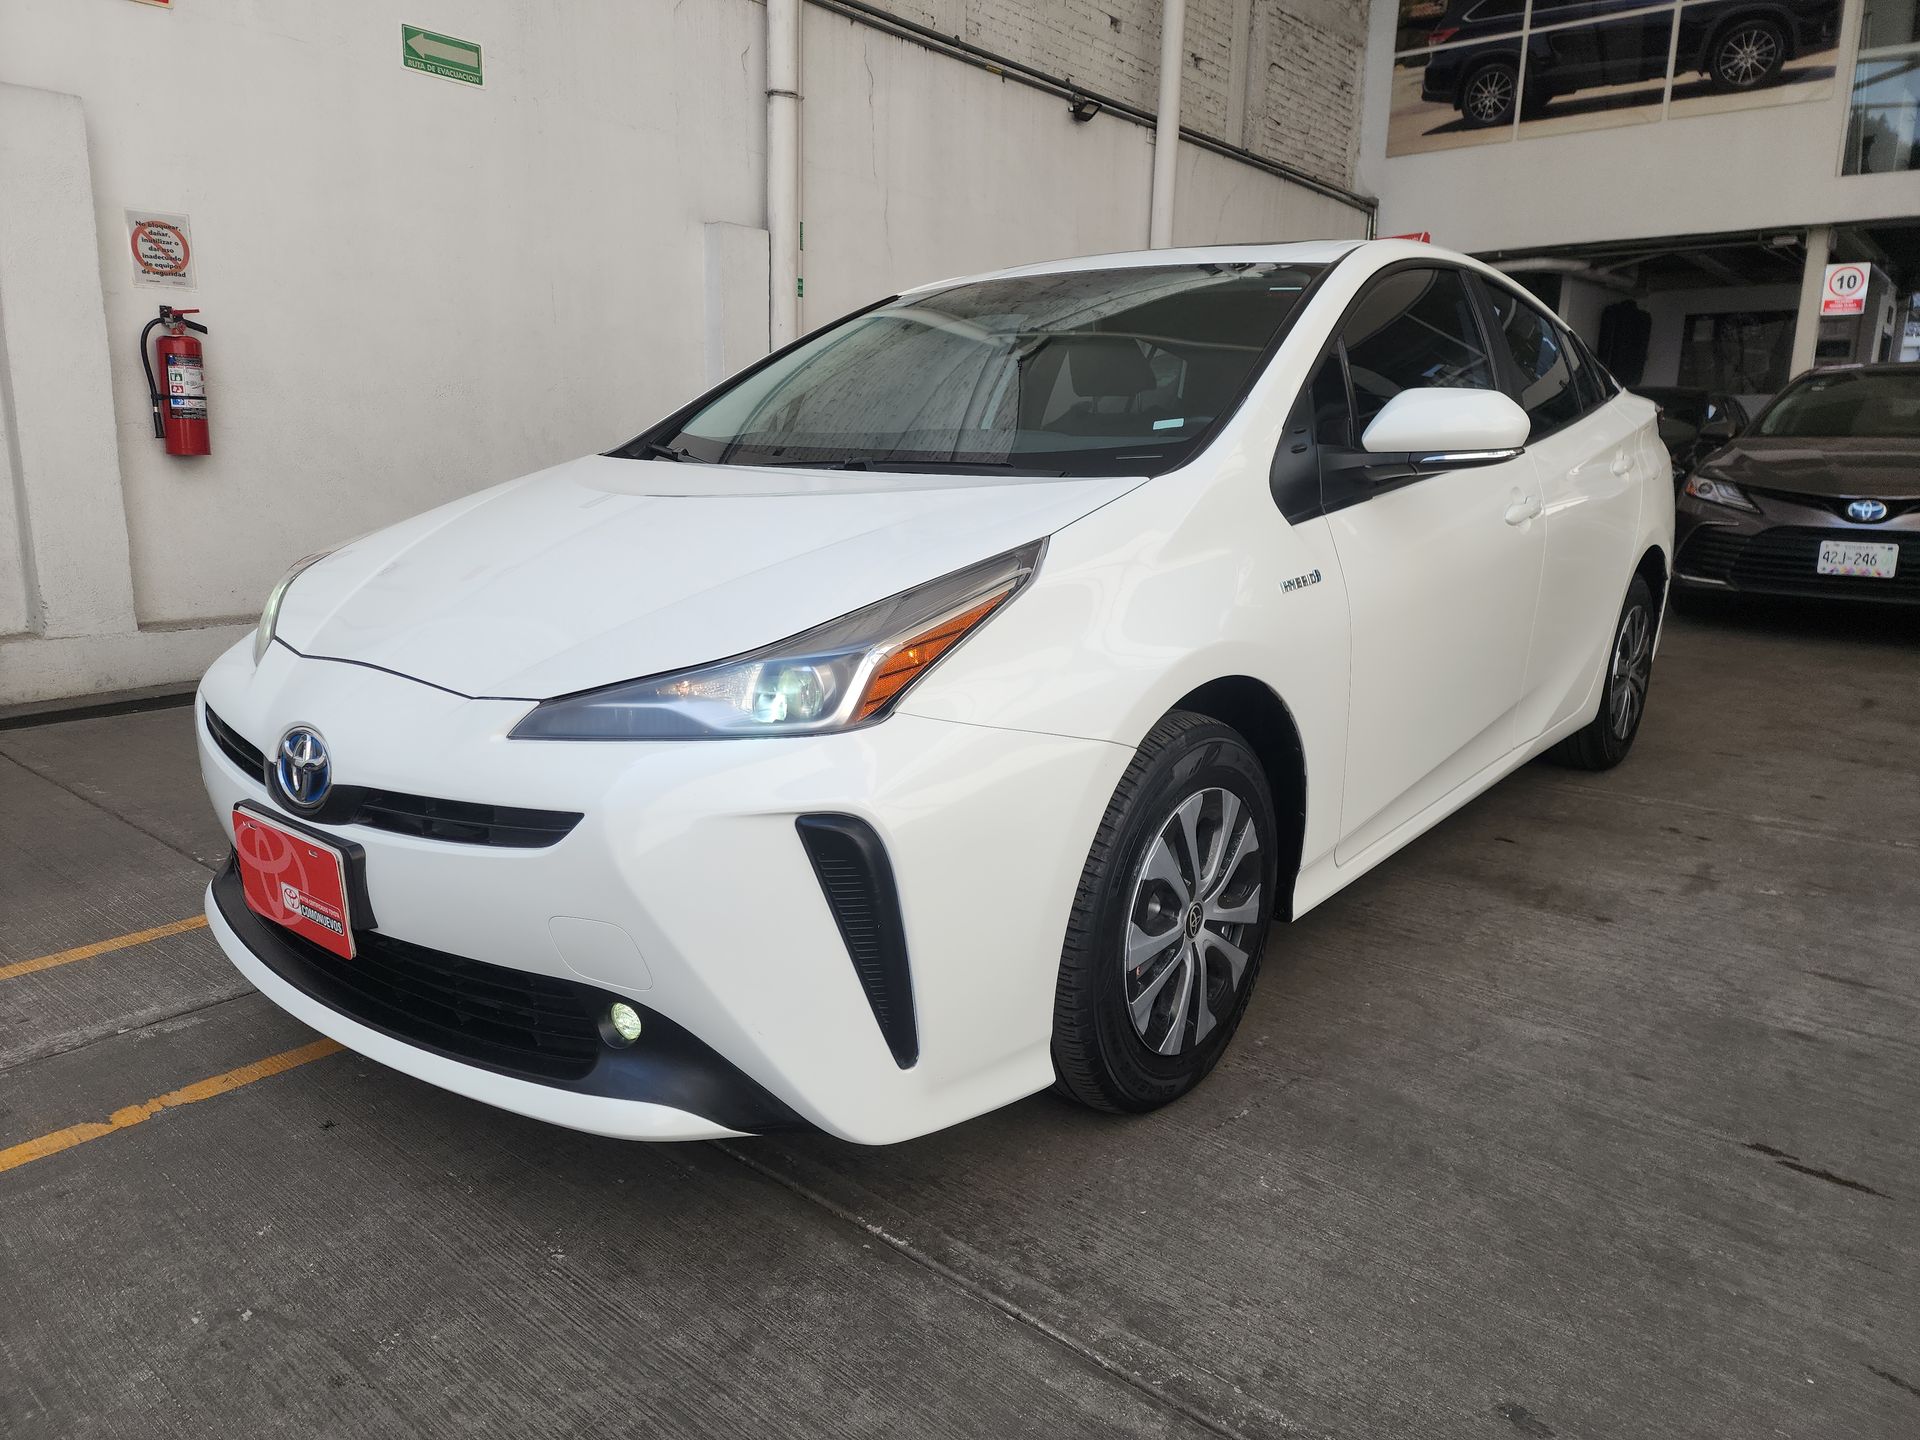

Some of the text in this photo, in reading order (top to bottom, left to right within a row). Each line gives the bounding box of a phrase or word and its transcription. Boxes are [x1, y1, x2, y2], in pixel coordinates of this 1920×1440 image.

[407, 59, 426, 70] RUTA
[427, 64, 436, 73] DE
[142, 252, 182, 262] inadecuado
[153, 269, 187, 278] seguridad
[1837, 275, 1858, 290] 10
[1280, 569, 1322, 594] HYBRID
